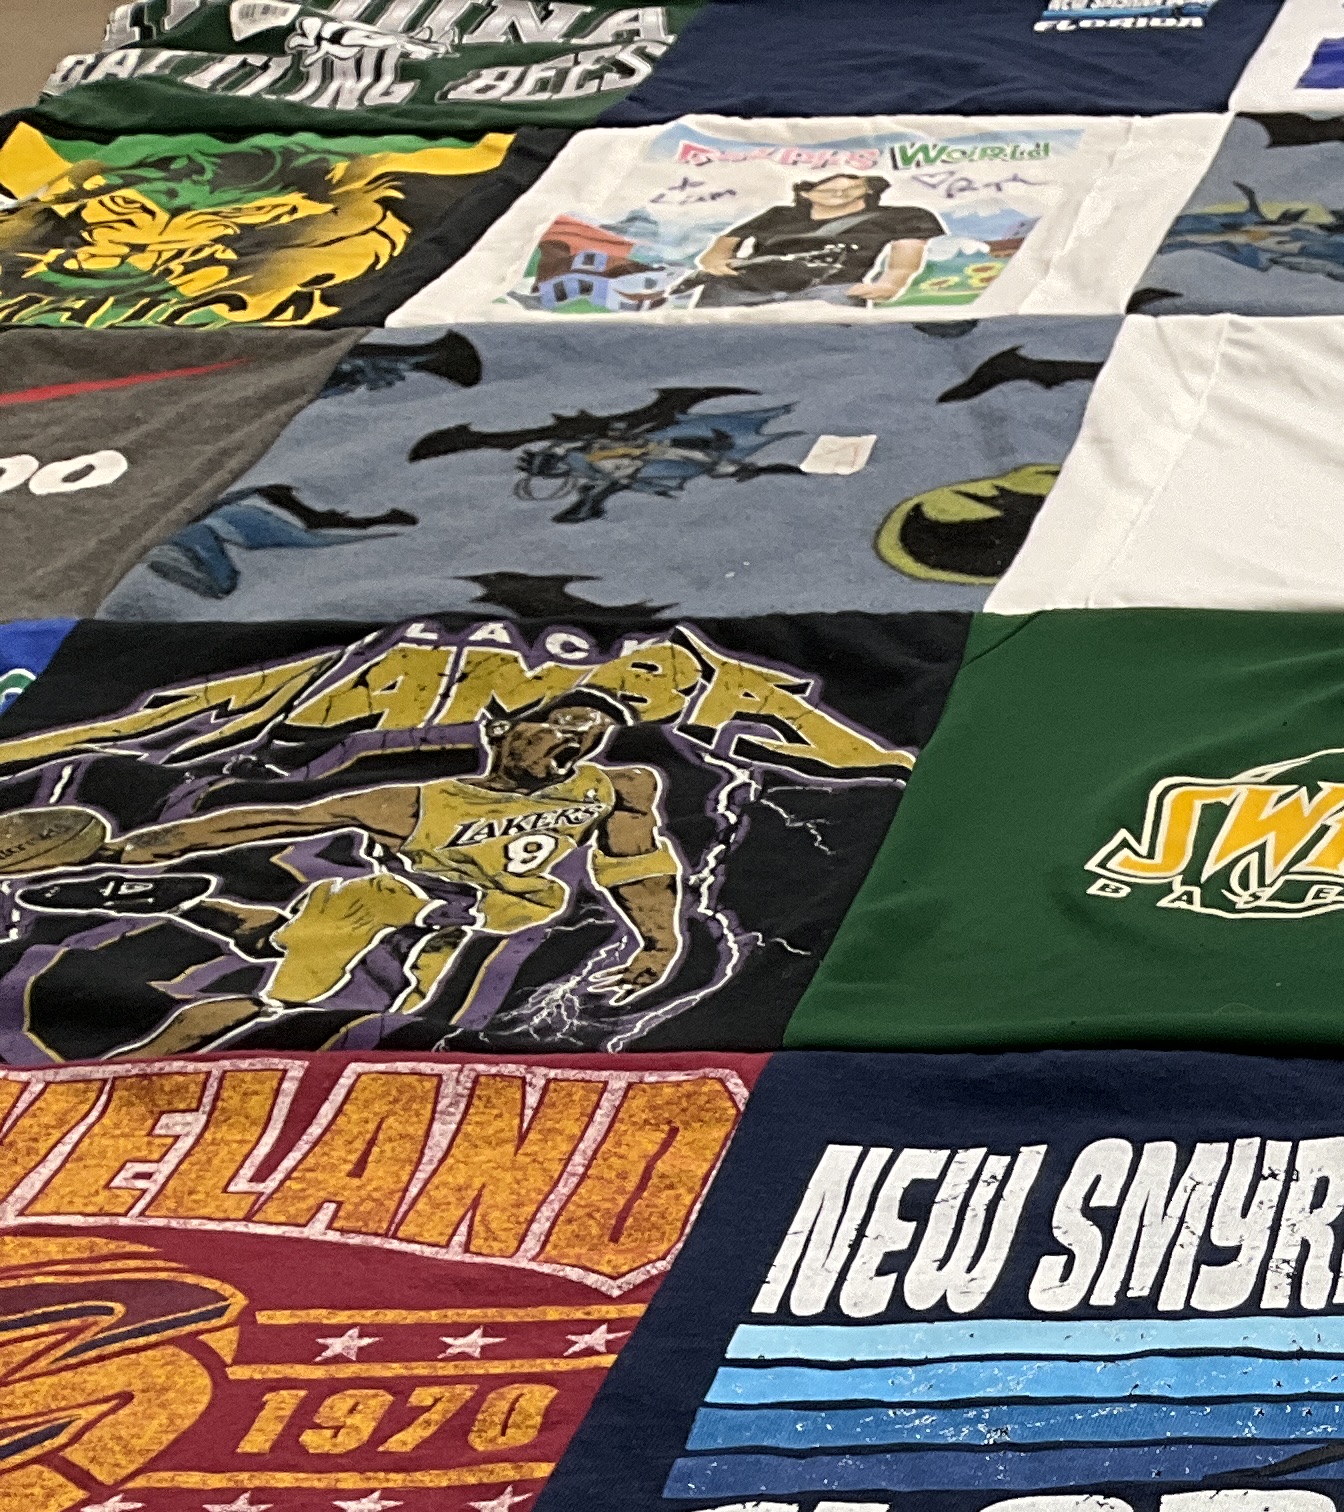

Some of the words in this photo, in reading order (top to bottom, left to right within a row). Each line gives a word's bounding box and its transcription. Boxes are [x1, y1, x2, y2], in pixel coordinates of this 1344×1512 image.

[1033, 17, 1205, 31] FLORIDA
[404, 622, 662, 660] LACK
[436, 803, 603, 850] LAKERS
[505, 833, 558, 875] 9
[751, 1143, 1047, 1319] NEW
[237, 1383, 560, 1453] 1970
